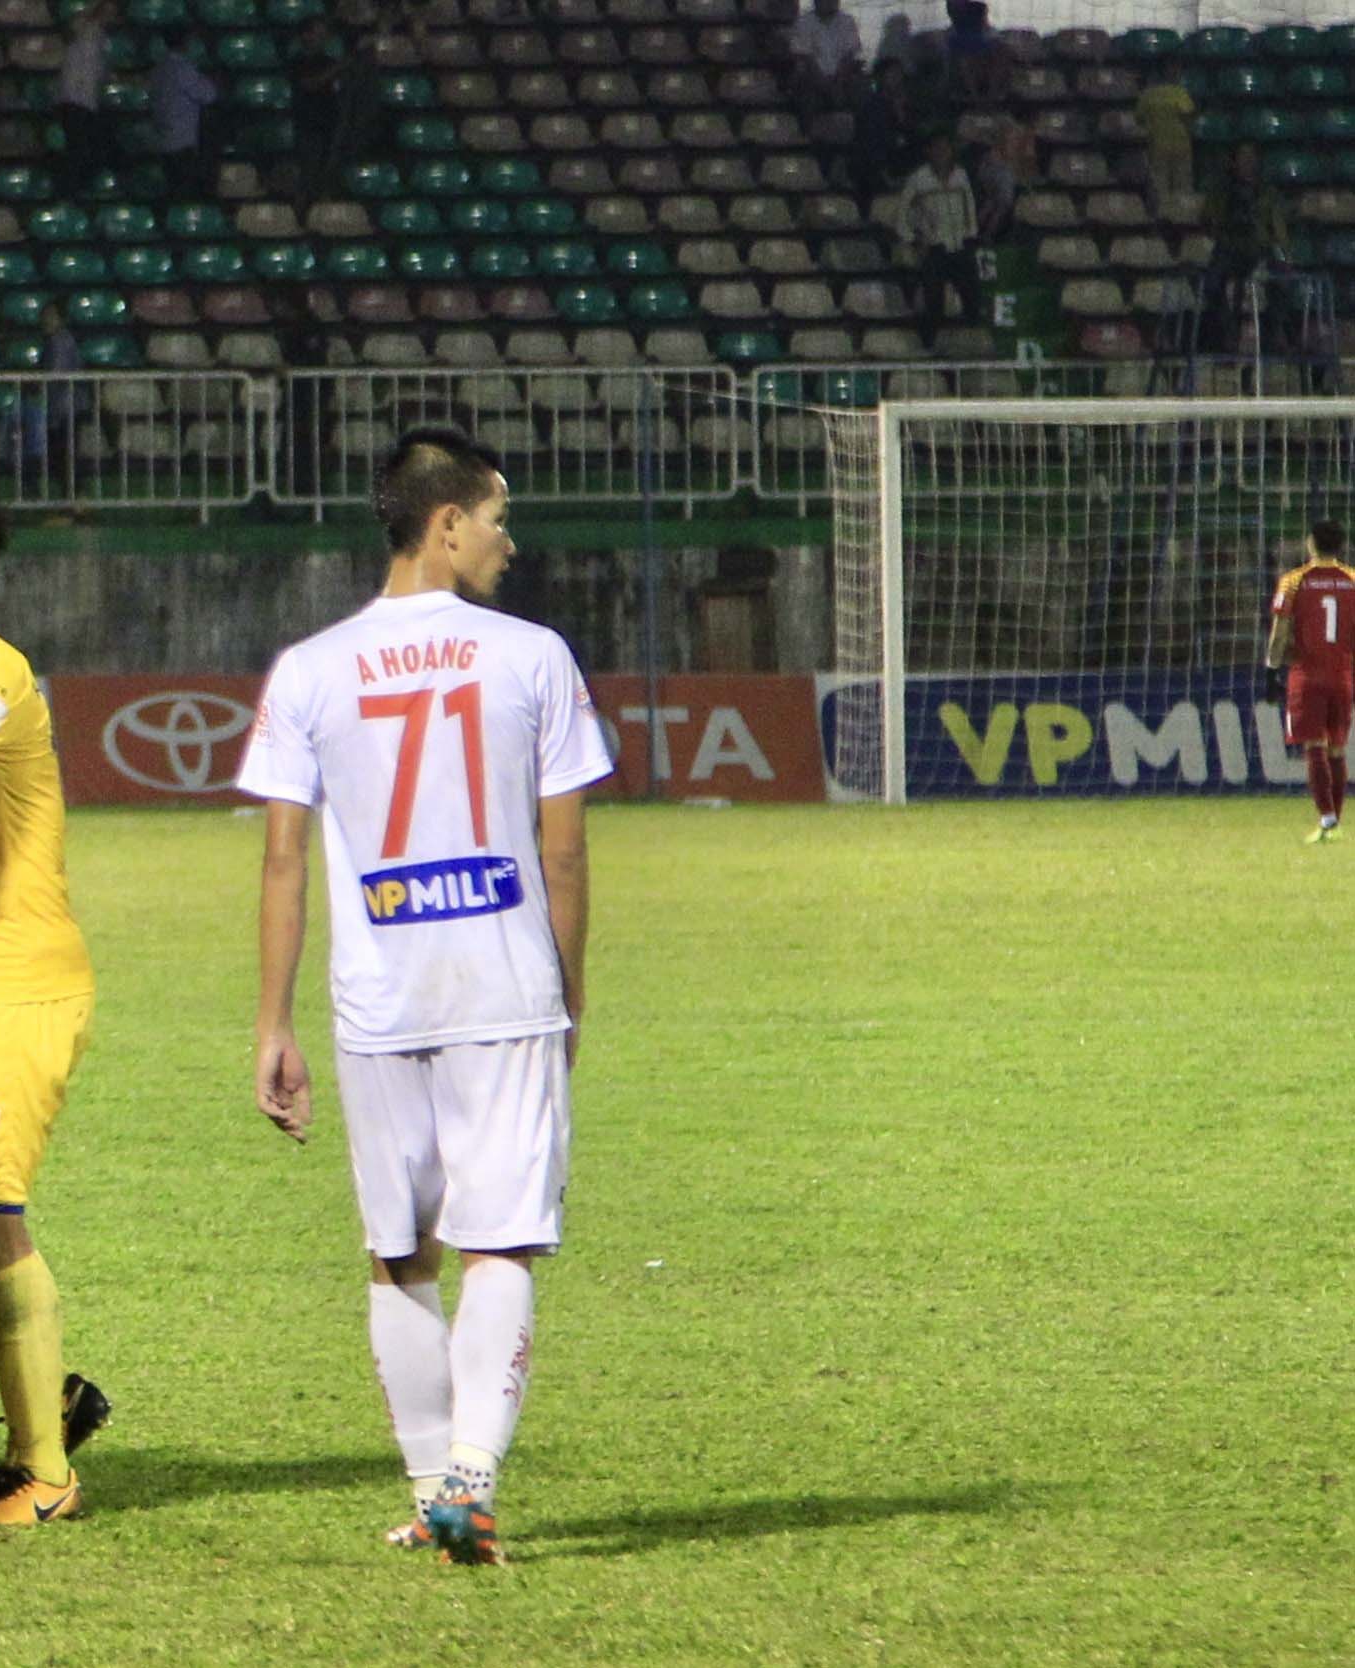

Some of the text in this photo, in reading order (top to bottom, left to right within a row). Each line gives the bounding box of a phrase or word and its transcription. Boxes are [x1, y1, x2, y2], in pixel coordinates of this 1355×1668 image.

[995, 294, 1017, 327] E
[1321, 595, 1338, 644] 1
[356, 652, 377, 686] A
[357, 681, 487, 859] 71
